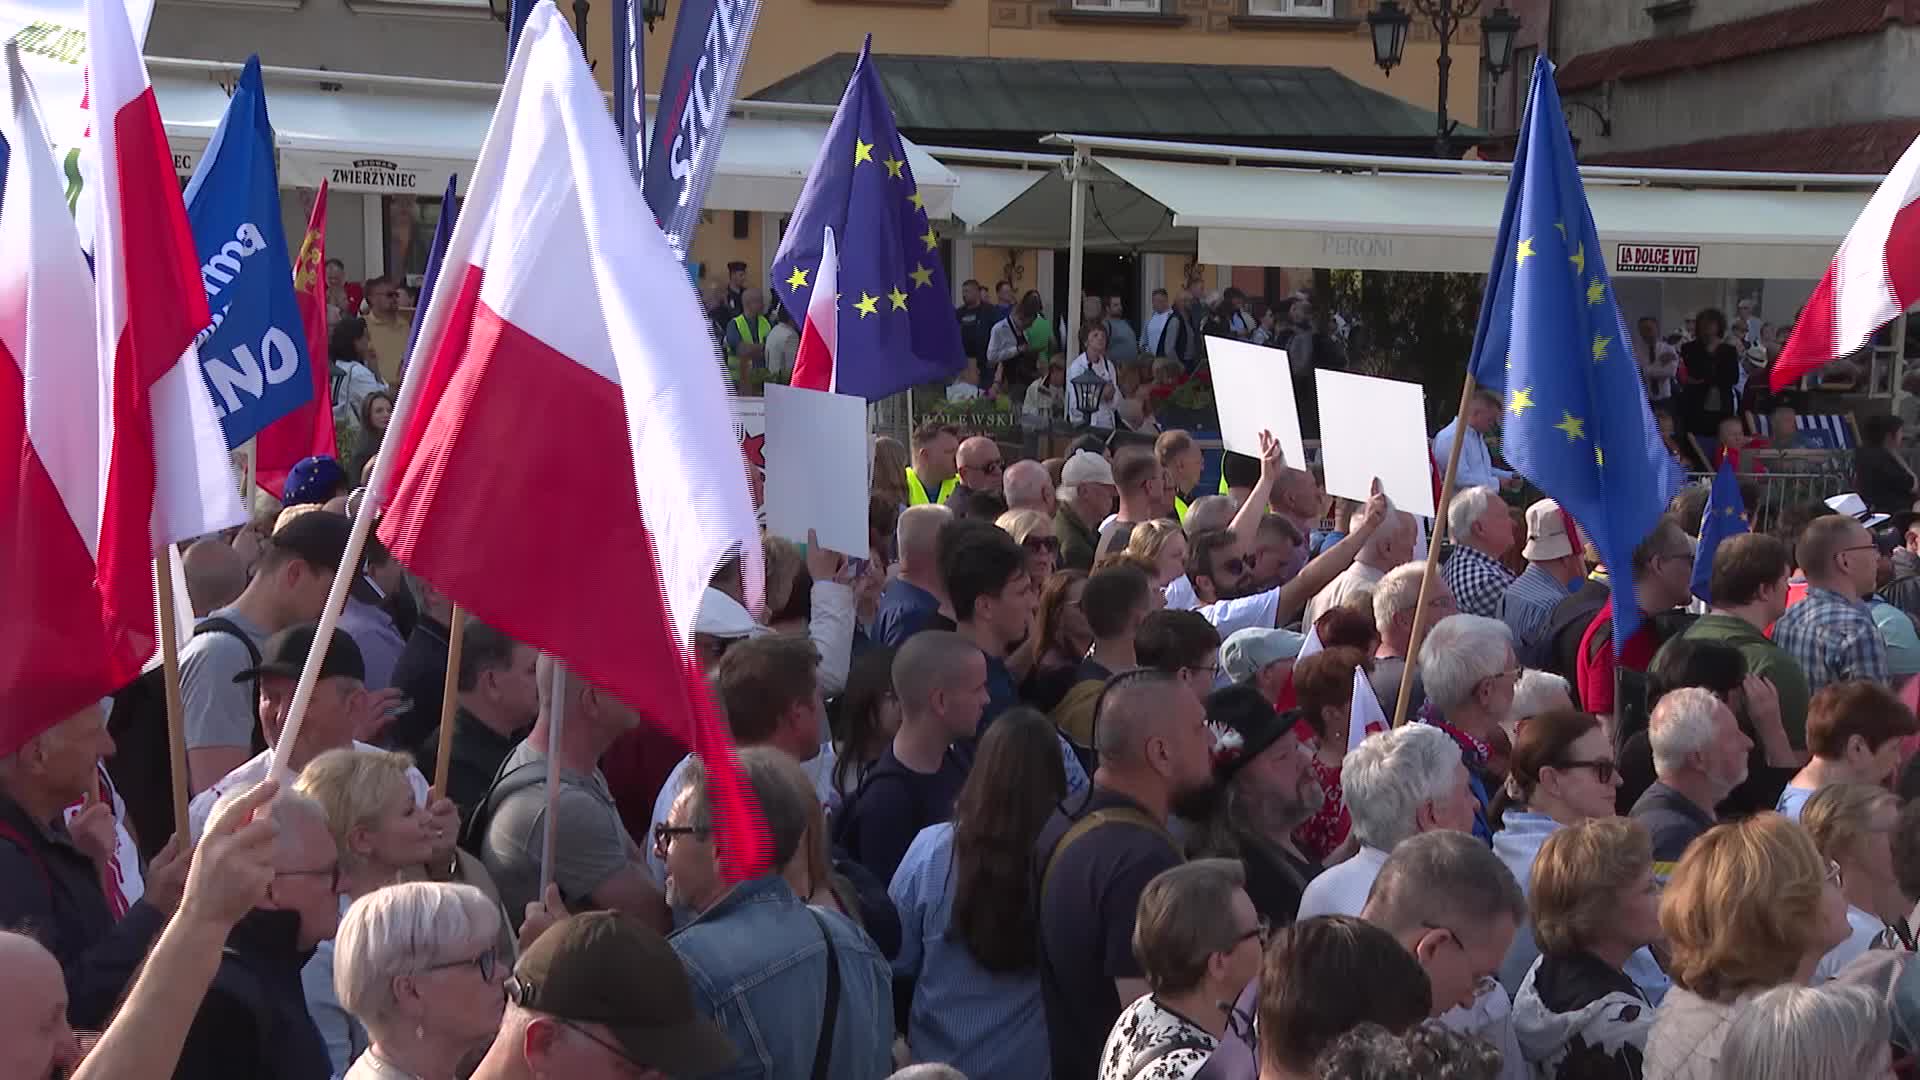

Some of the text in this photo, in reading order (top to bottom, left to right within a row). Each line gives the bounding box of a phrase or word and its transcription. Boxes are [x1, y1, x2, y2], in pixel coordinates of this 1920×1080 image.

[669, 0, 749, 207] SZCZE
[332, 168, 416, 188] ZWIERZYNIEC
[1321, 232, 1393, 257] PERONI
[1621, 247, 1697, 265] LA DOLCE VITA
